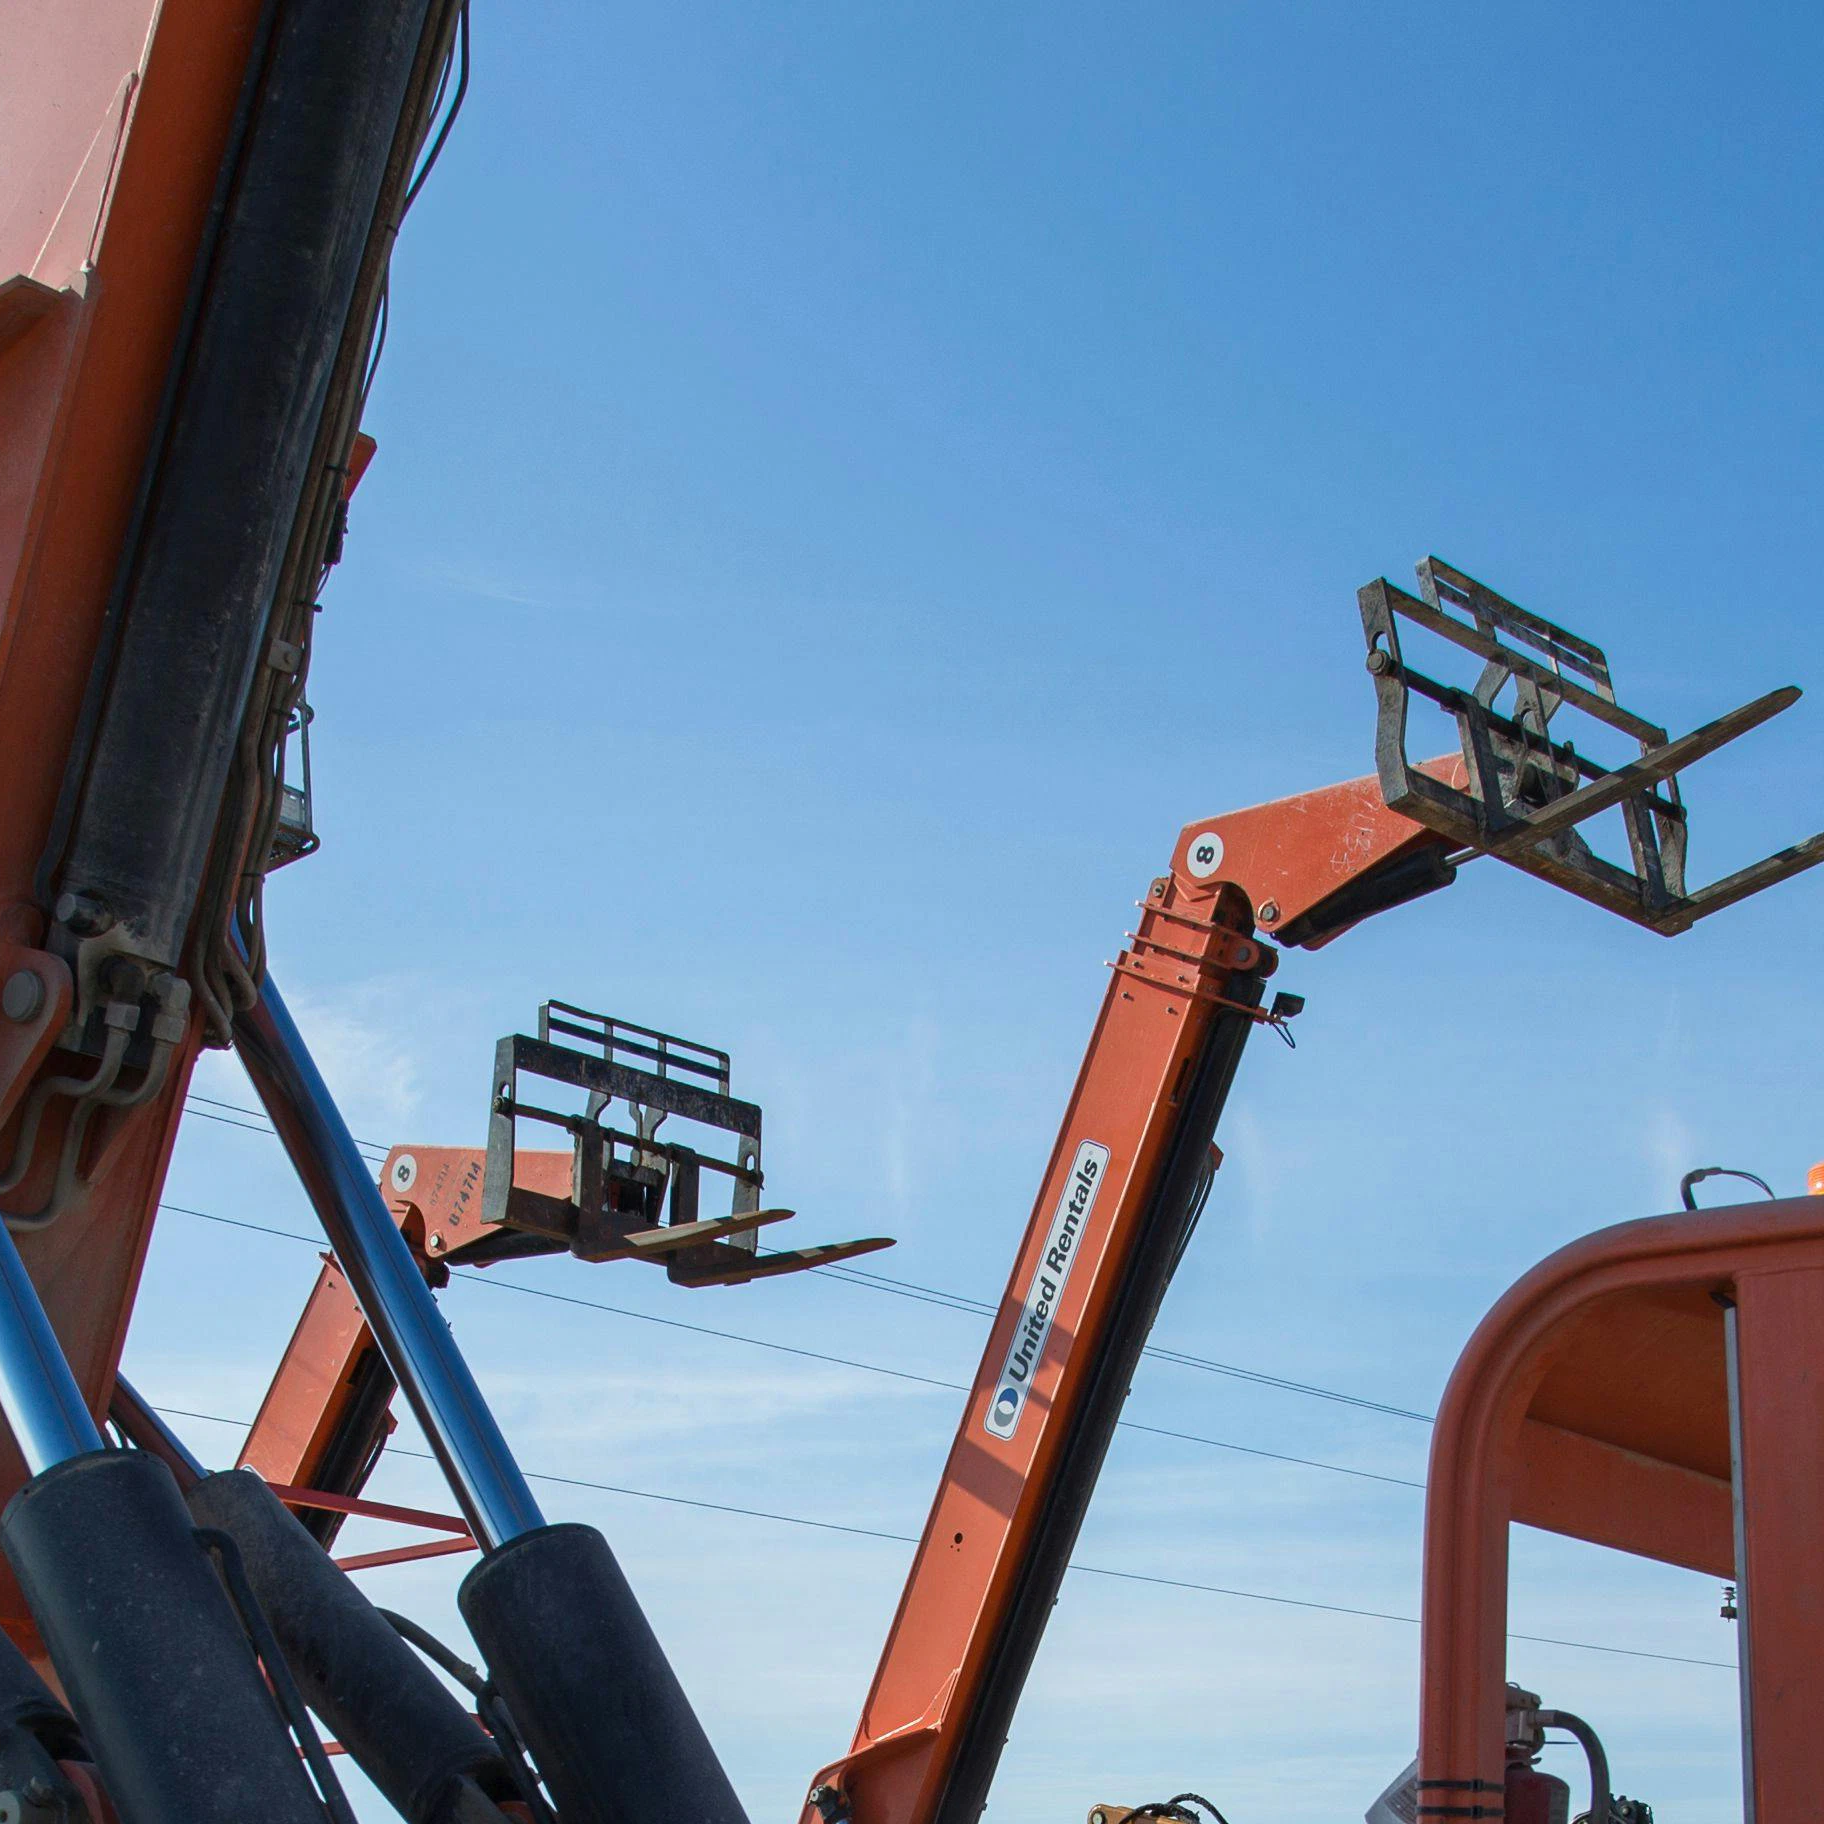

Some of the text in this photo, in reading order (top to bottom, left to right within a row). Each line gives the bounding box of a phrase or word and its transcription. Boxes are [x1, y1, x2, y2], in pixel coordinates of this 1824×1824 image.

[397, 1165, 411, 1183] 8
[1008, 1158, 1098, 1384] United Rentals
